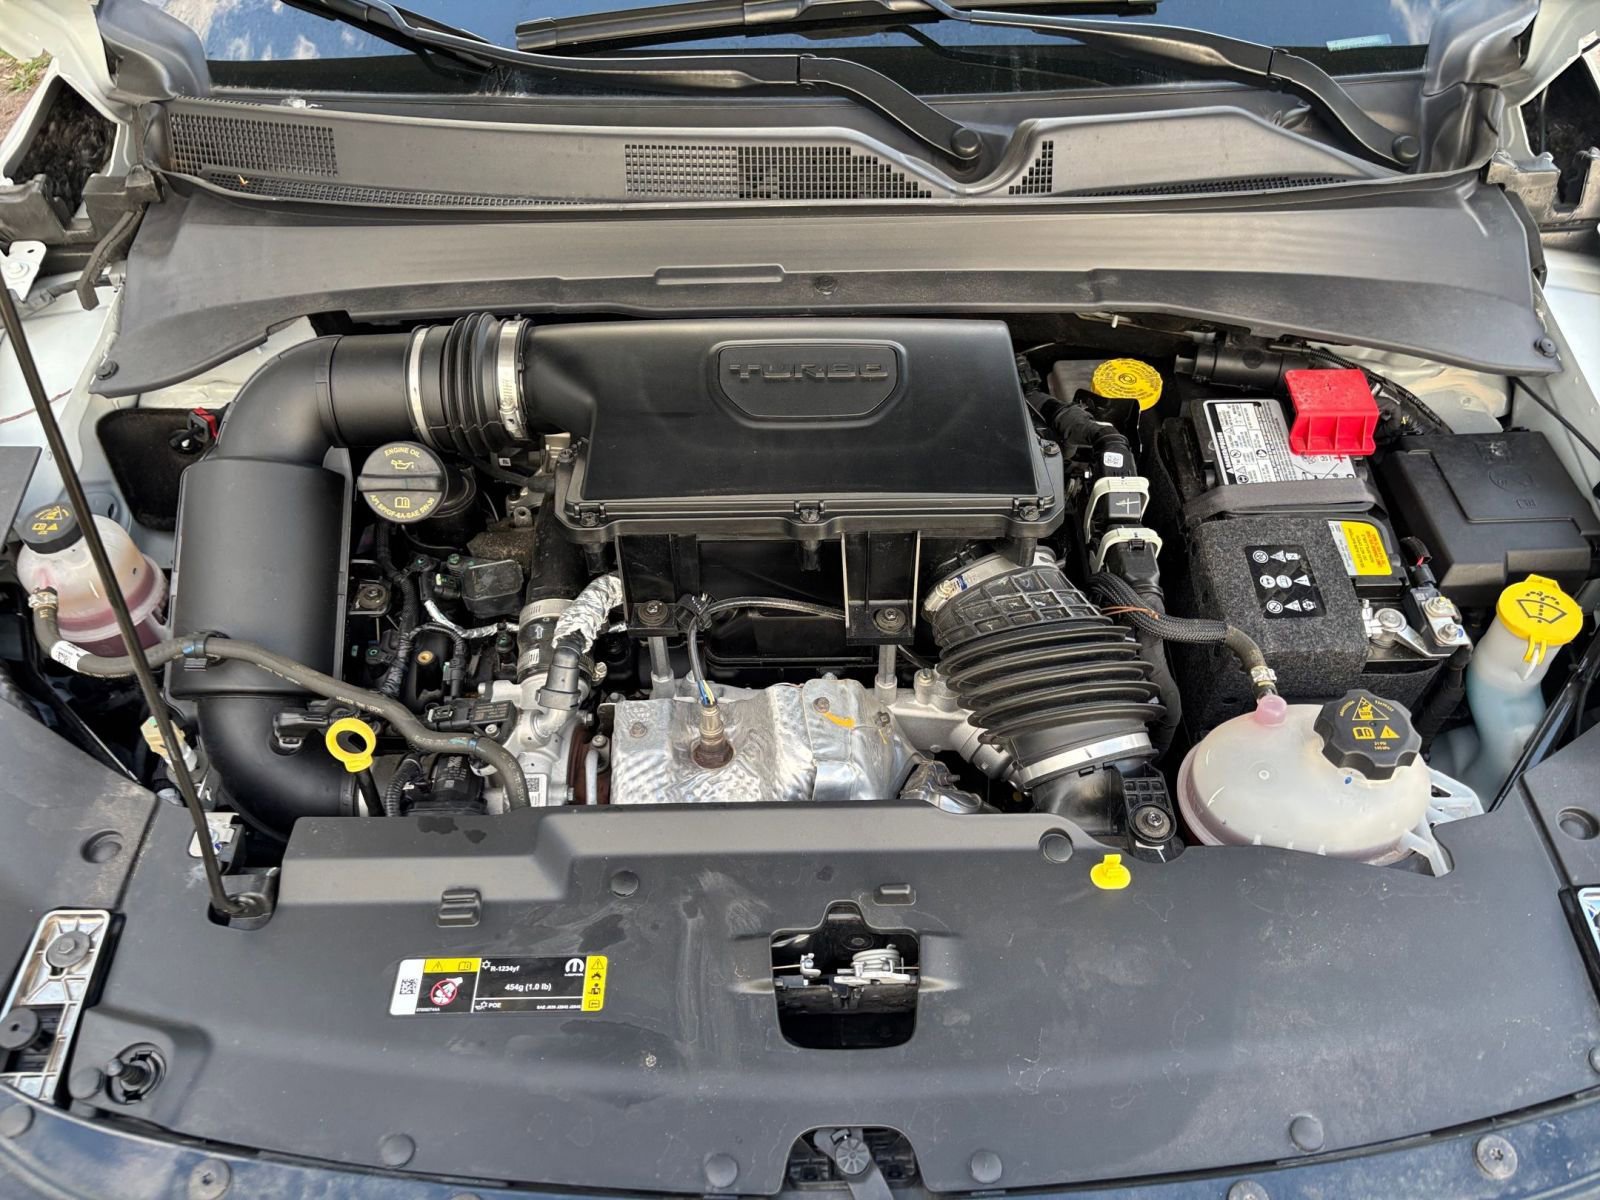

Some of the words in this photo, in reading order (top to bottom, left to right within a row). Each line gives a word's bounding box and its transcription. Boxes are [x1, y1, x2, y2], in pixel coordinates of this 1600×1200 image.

[728, 364, 889, 382] TURBO
[384, 448, 408, 457] ENGINE
[409, 448, 421, 458] OIL
[490, 965, 520, 973] R-1234yf
[504, 983, 524, 992] 454g
[541, 983, 552, 991] lb)
